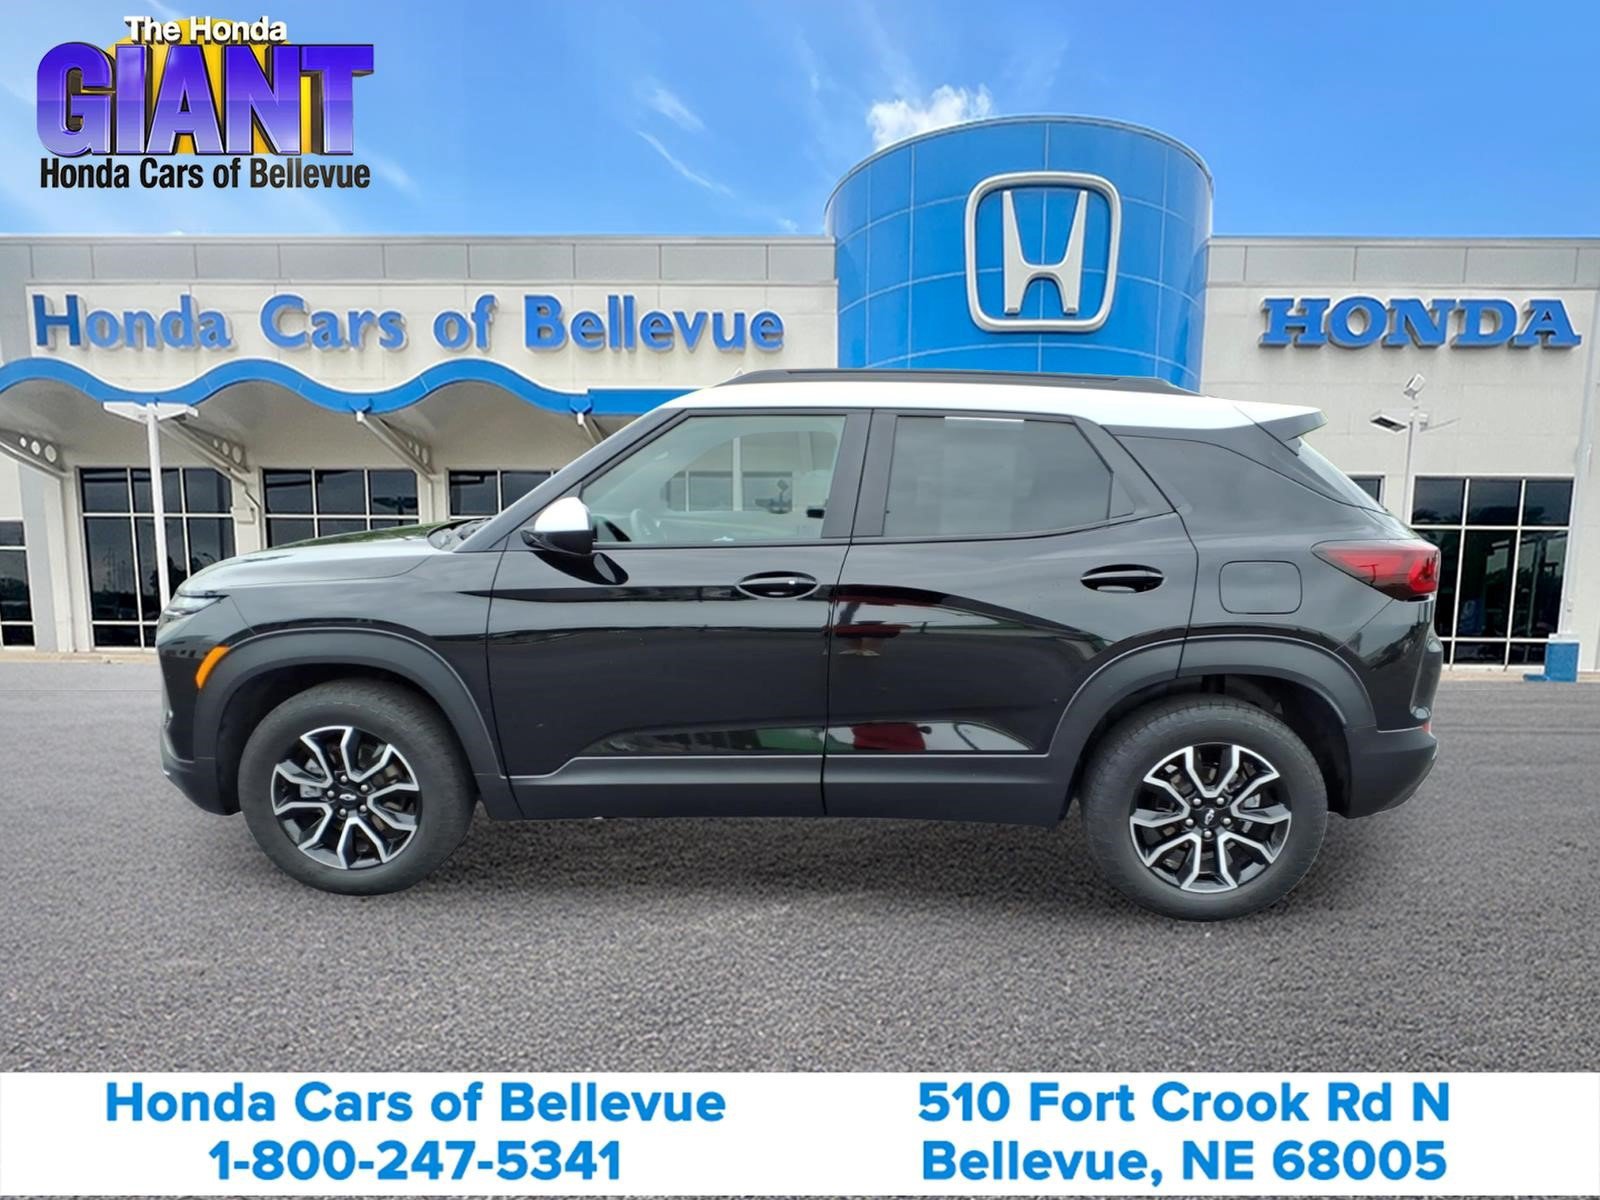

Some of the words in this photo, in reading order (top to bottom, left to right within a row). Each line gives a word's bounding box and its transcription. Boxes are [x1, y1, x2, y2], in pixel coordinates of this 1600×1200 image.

[32, 294, 232, 350] Honda
[260, 294, 406, 350] Cars
[433, 294, 497, 350] of
[524, 295, 785, 351] Bellevue
[1260, 297, 1581, 347] HONDA
